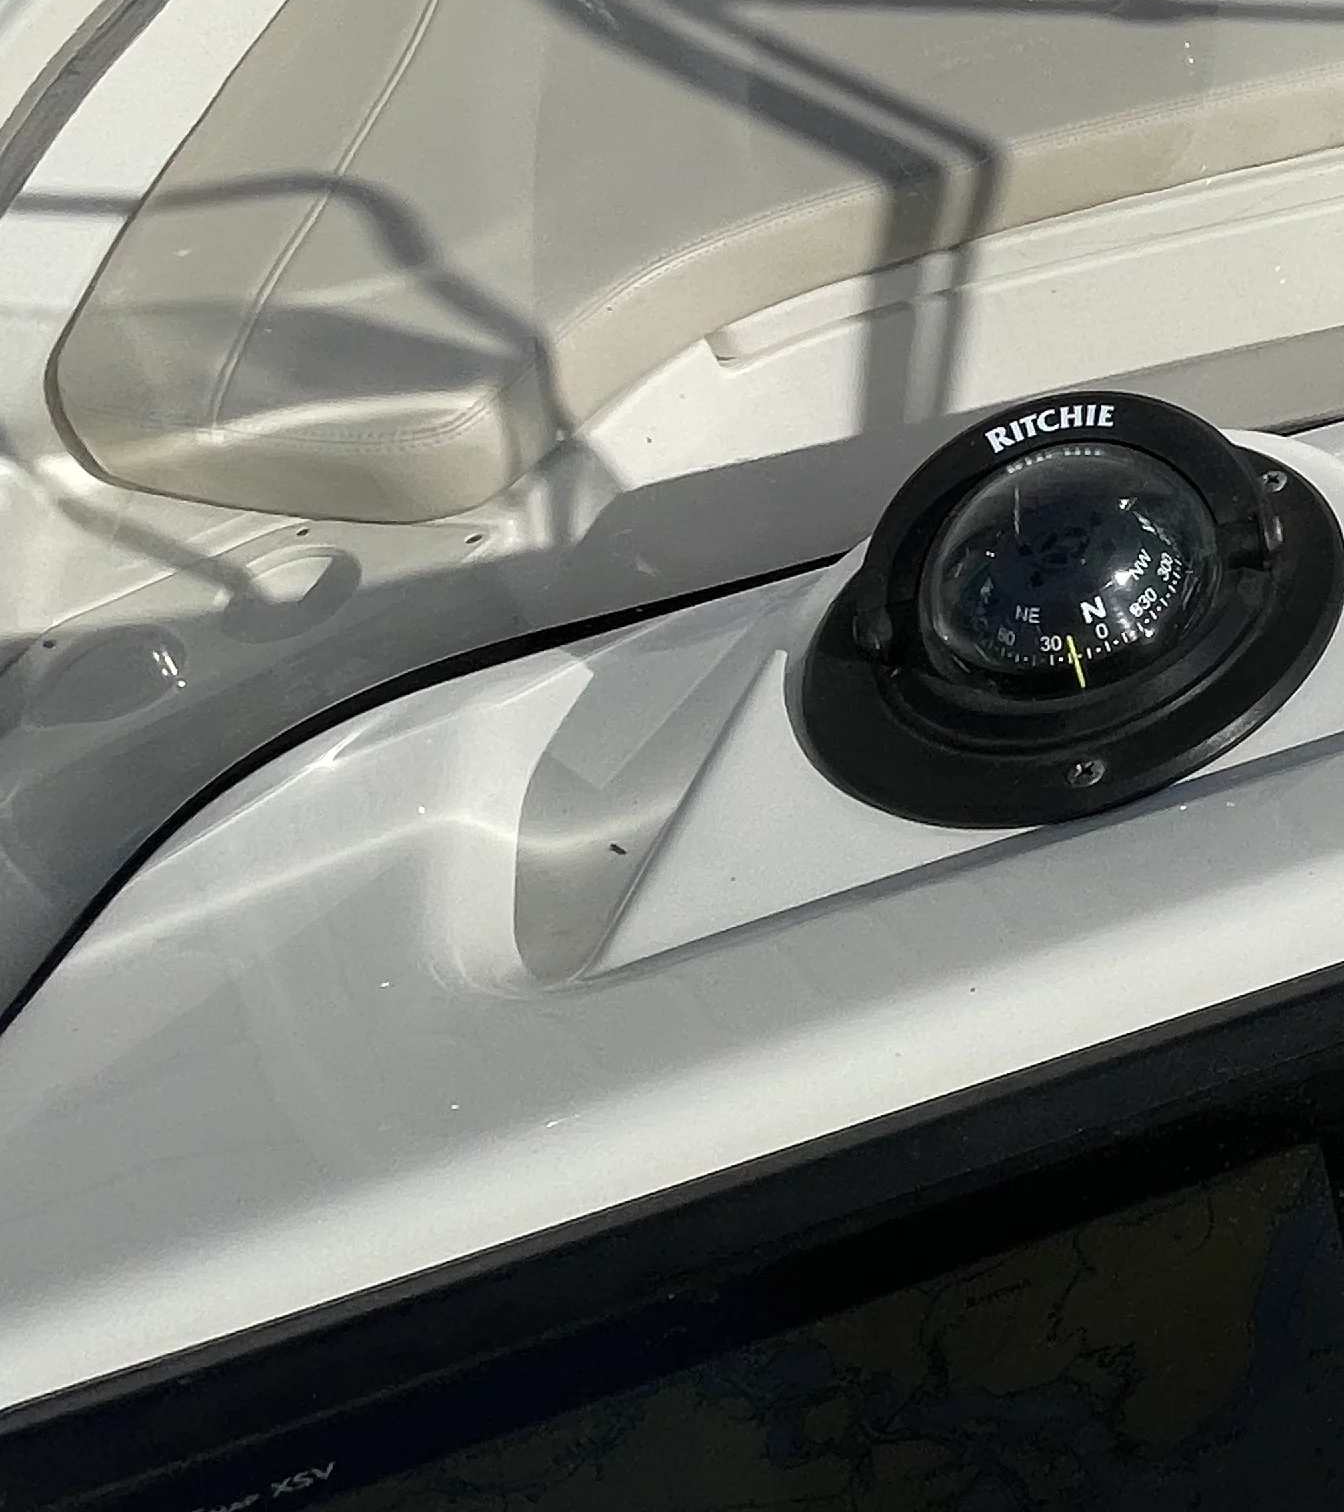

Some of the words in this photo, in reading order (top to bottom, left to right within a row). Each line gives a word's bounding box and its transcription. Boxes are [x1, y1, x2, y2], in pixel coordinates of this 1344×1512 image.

[984, 404, 1116, 454] RITCHIE
[1128, 548, 1153, 581] NW
[1014, 604, 1041, 625] NE
[1079, 596, 1108, 625] N
[1040, 635, 1063, 652] 30
[1095, 623, 1110, 640] 0
